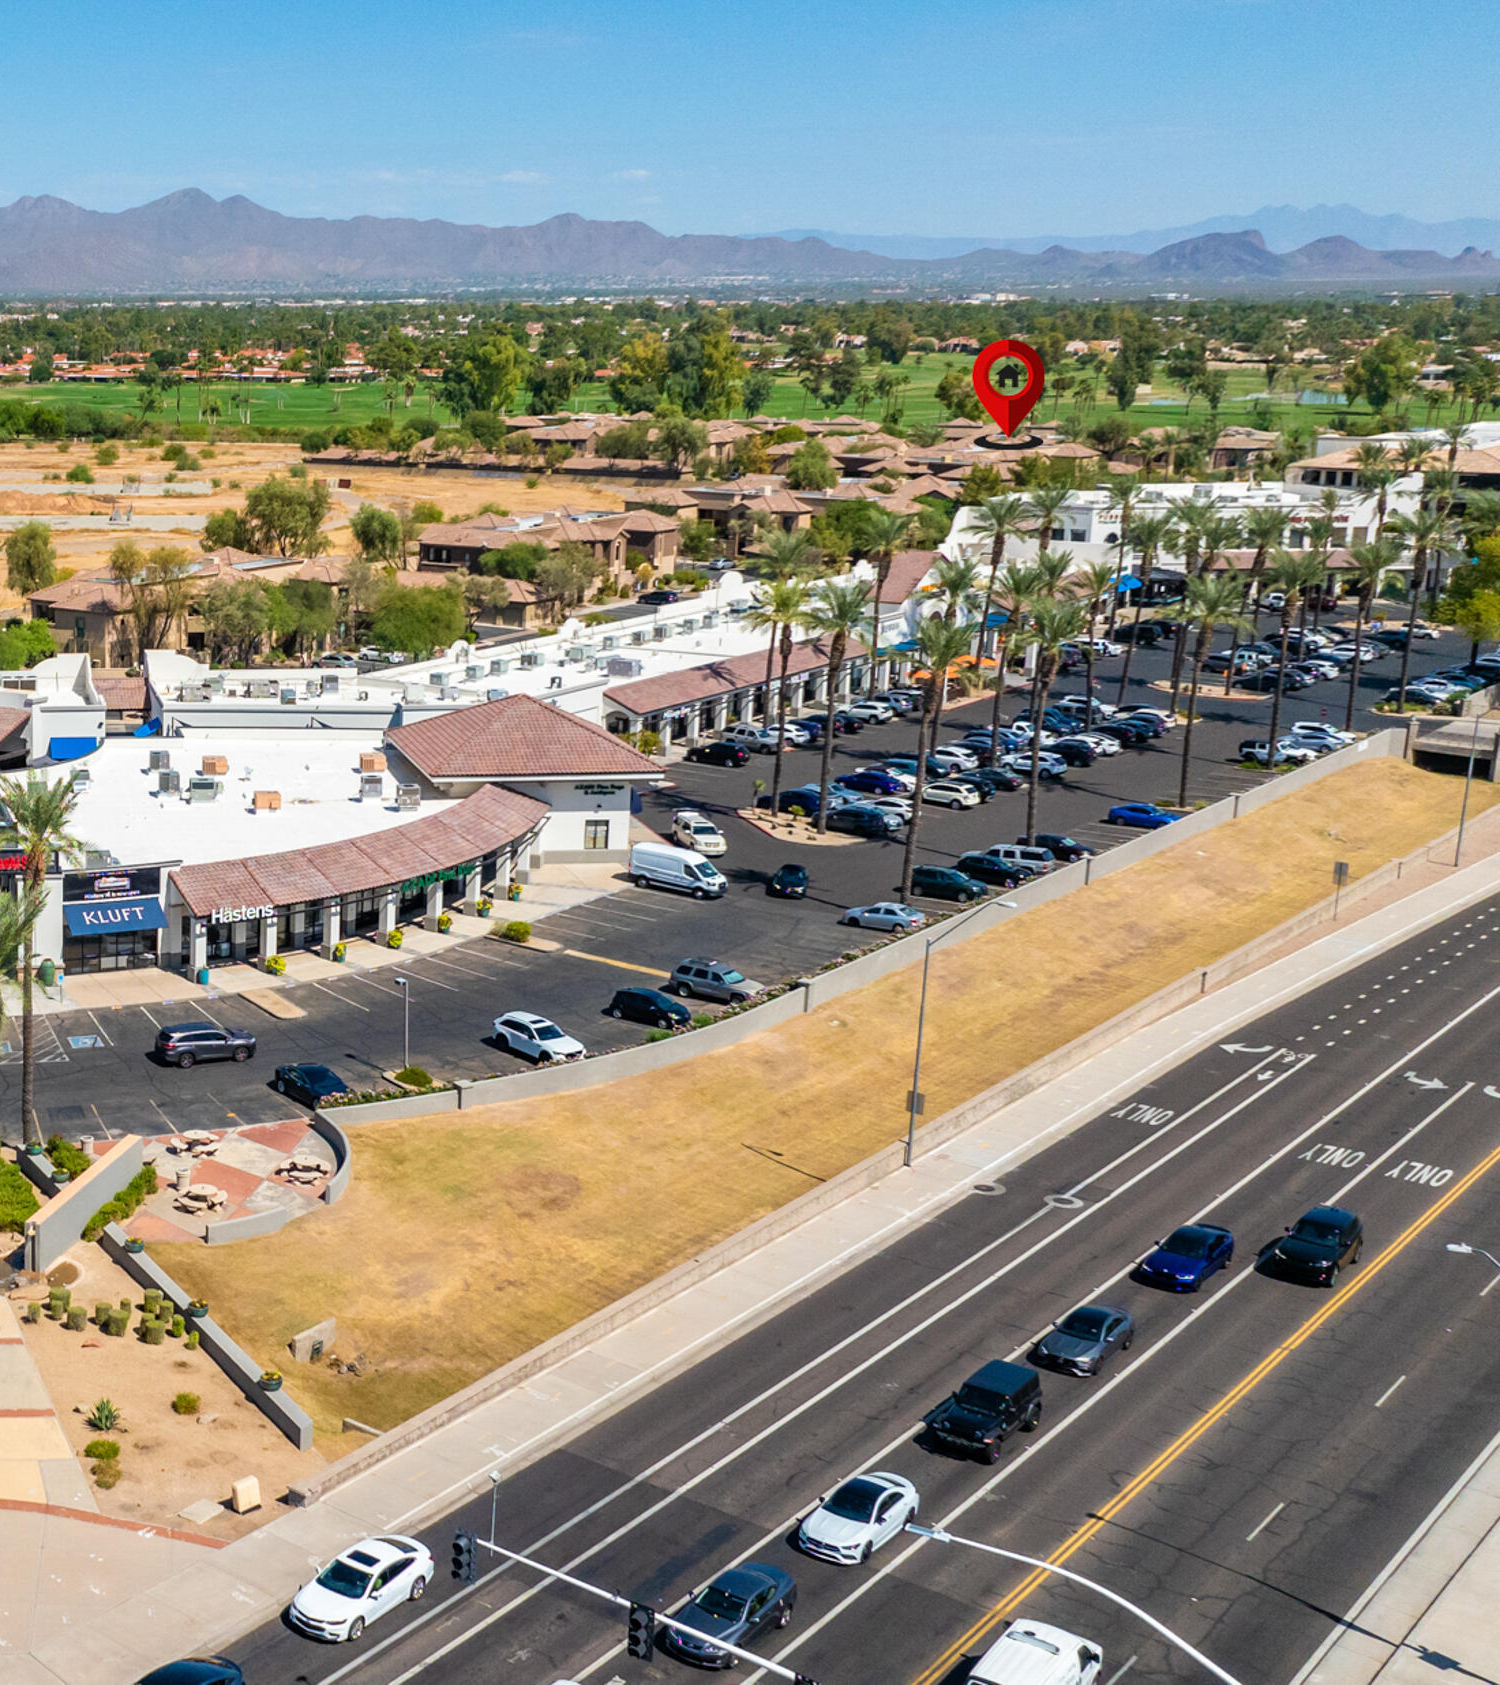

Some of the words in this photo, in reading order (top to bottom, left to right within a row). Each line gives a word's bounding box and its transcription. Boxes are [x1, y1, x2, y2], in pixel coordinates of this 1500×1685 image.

[82, 907, 144, 925] KLUFT
[211, 904, 274, 924] Hästens
[1110, 1102, 1175, 1126] ONLY
[1297, 1143, 1366, 1168] ONLY
[1384, 1159, 1454, 1187] ONLY
